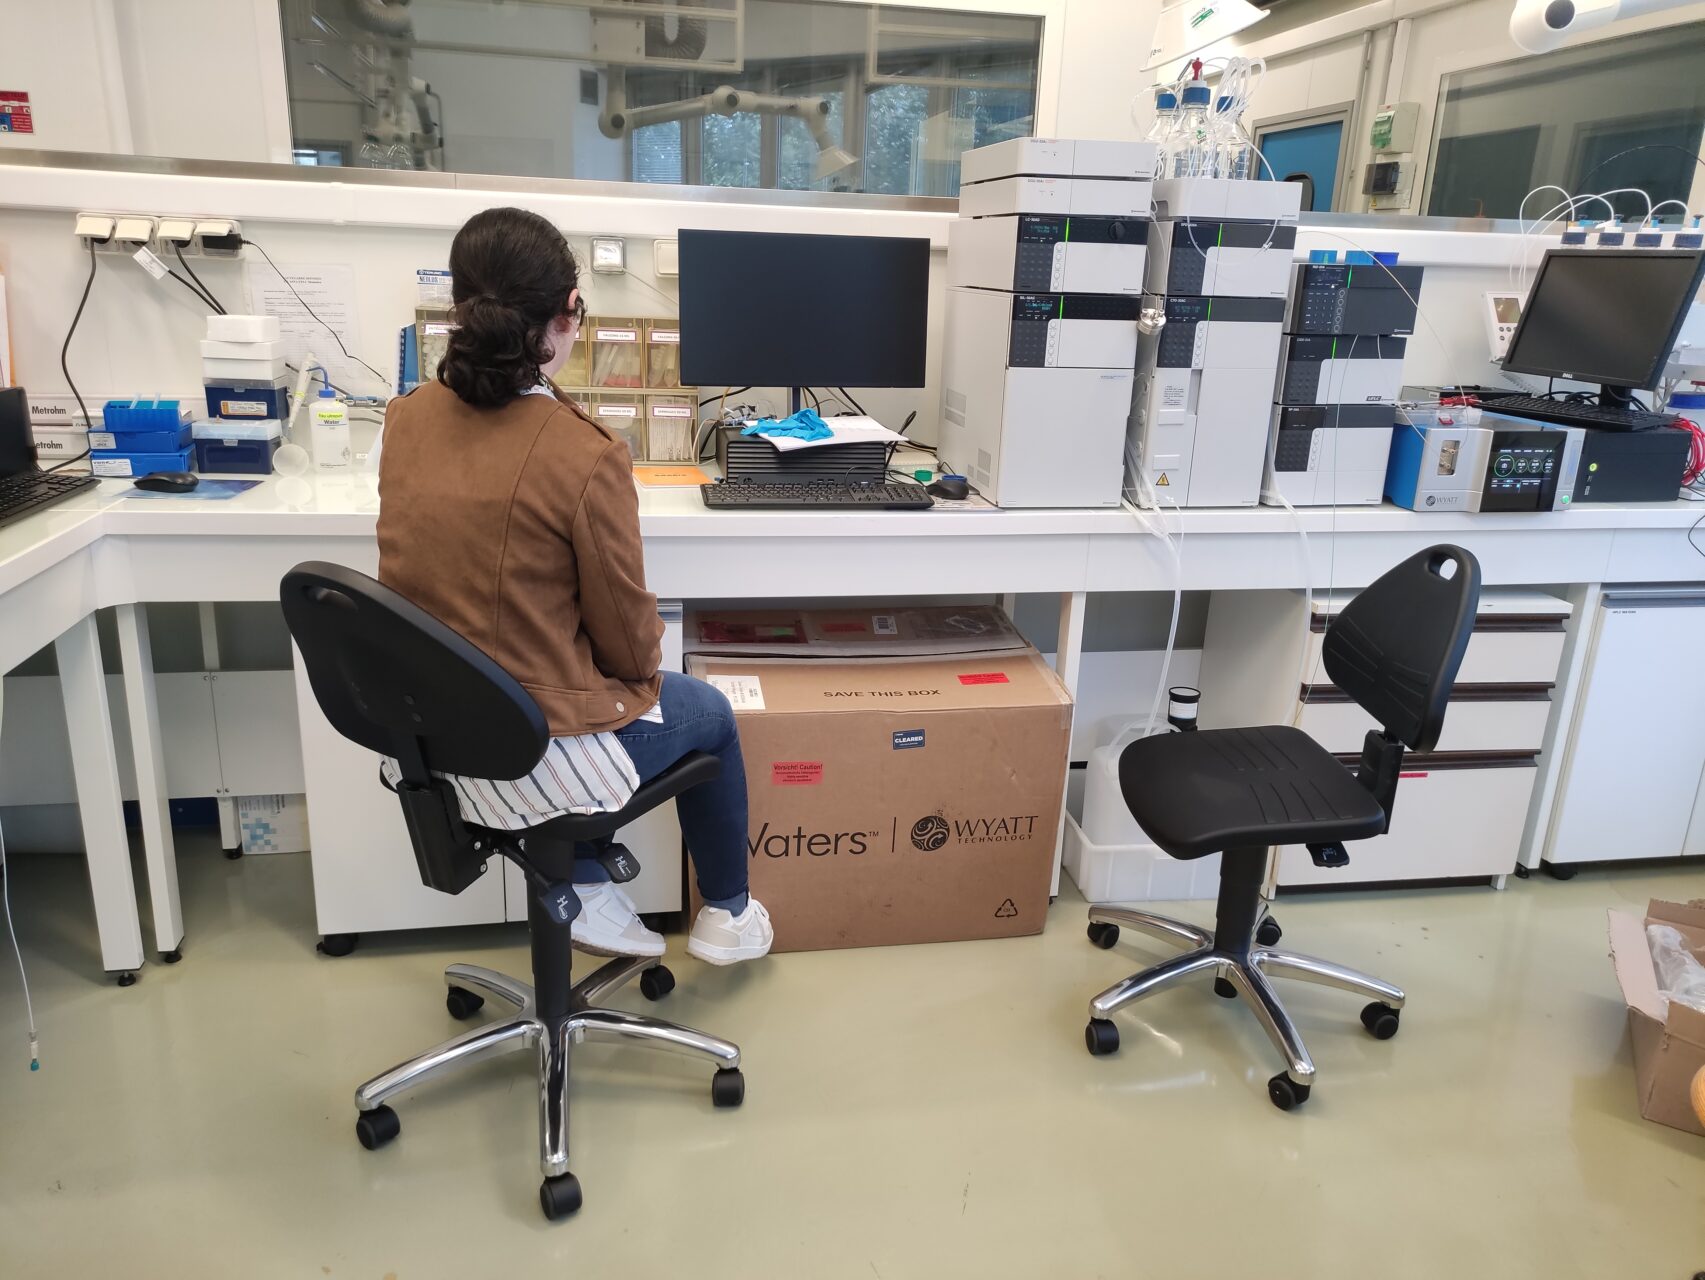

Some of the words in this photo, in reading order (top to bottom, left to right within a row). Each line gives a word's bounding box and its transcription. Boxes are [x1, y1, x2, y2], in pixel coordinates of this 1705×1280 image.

[32, 406, 67, 415] Metrohm
[35, 440, 63, 450] etrohm
[823, 690, 864, 698] SAVE
[894, 735, 924, 743] CLEARED
[954, 815, 1039, 837] WYATT
[957, 834, 1033, 844] TECHNOLOGY
